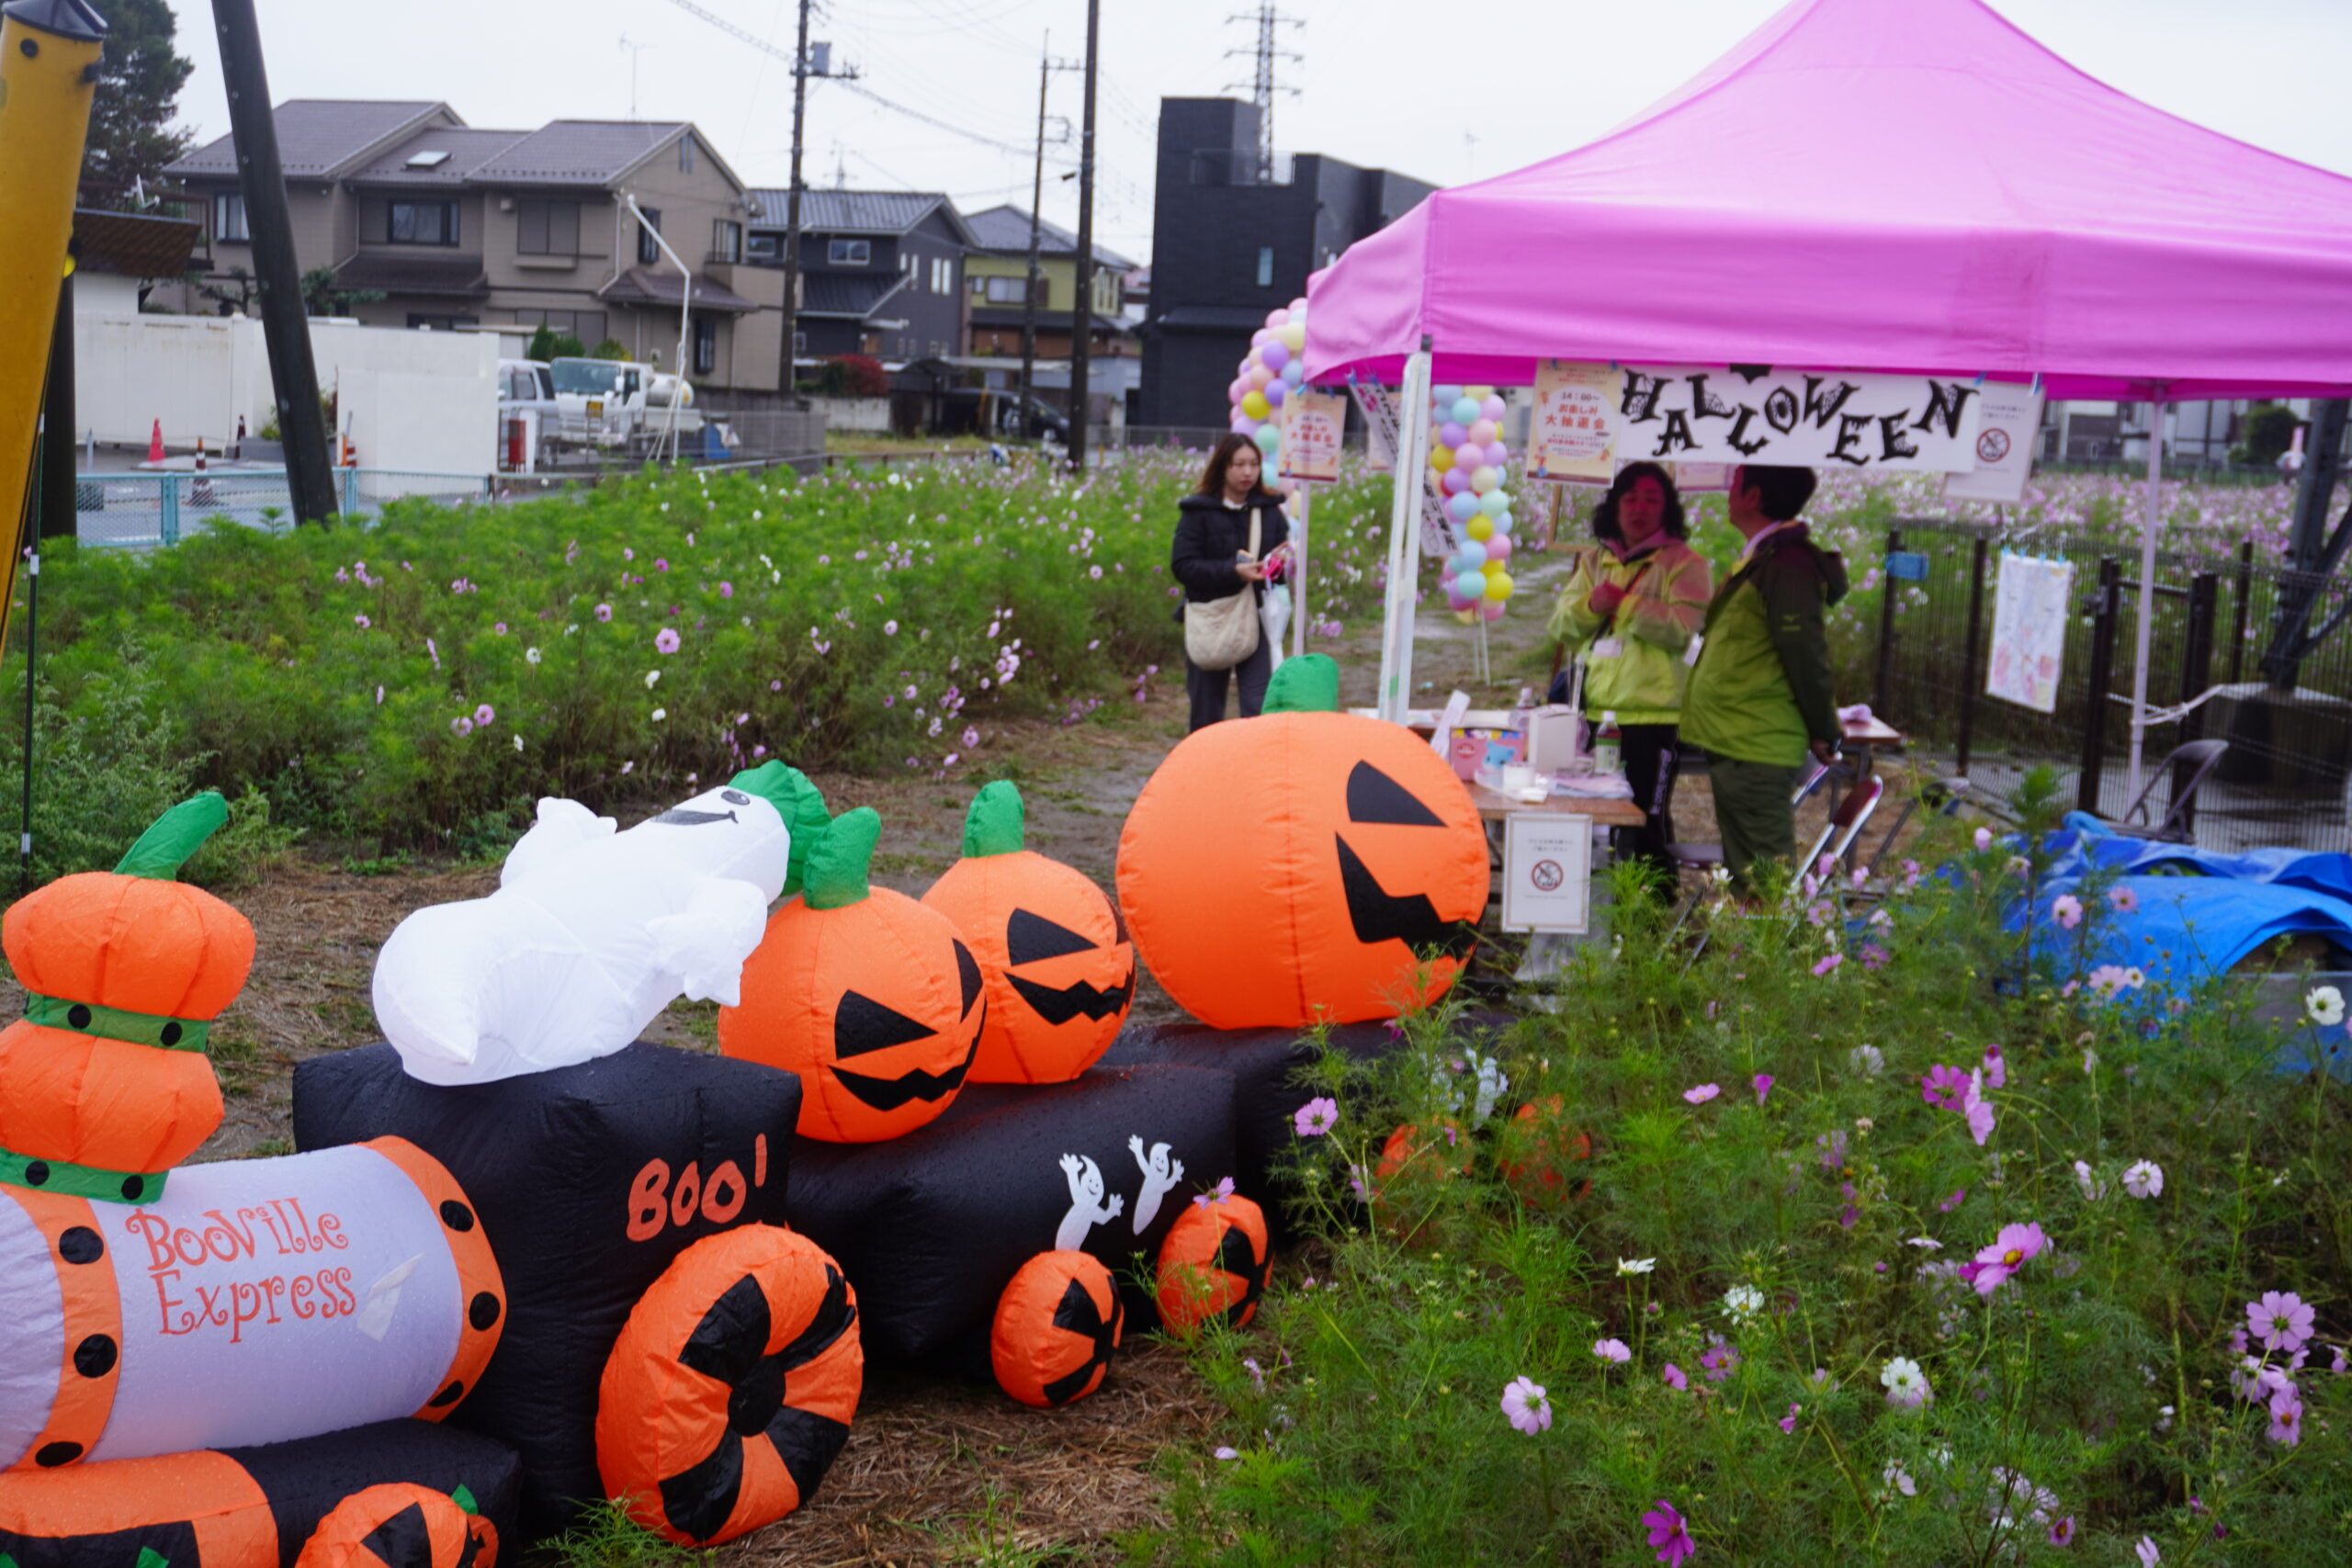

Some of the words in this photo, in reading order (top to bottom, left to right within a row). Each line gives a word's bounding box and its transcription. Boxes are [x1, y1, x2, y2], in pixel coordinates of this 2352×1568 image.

[1545, 413, 1606, 431] 大抽選会
[1621, 368, 1981, 466] HALLOWEEN
[150, 1267, 356, 1344] Express
